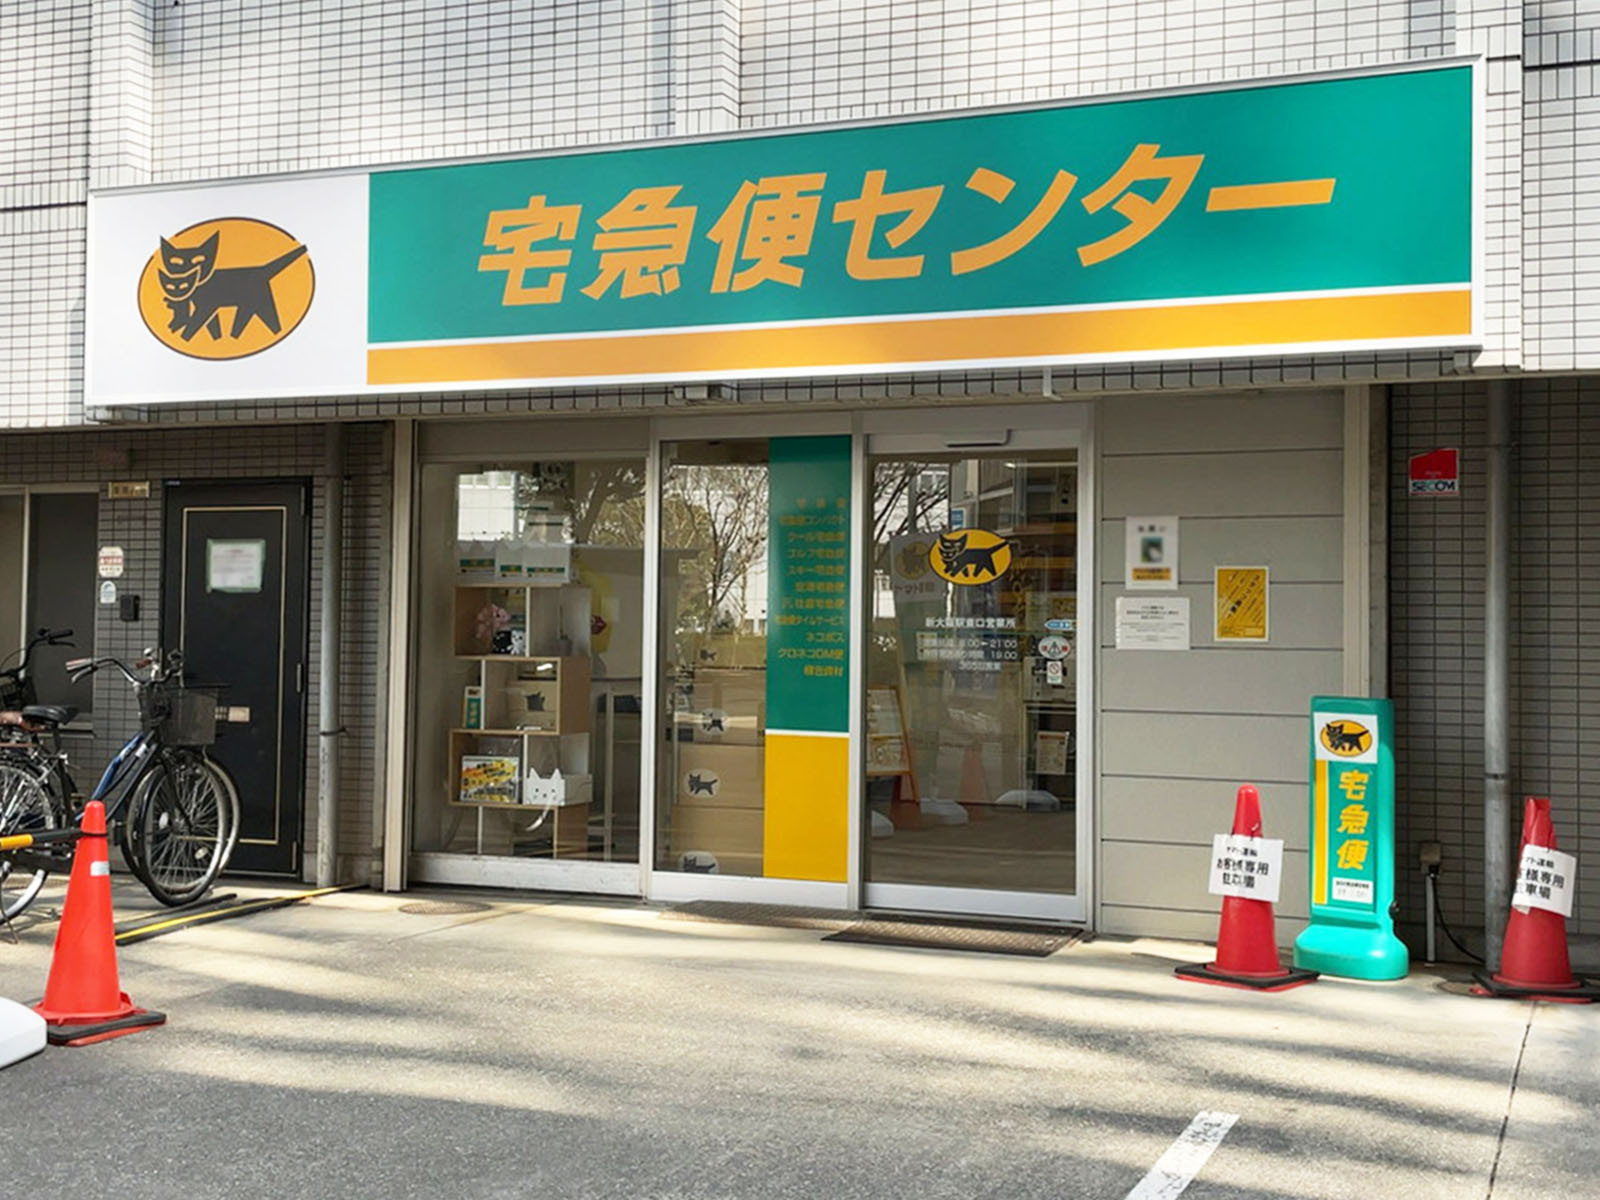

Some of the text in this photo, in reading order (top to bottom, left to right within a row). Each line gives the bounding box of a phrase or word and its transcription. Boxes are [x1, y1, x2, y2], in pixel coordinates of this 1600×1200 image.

[477, 143, 1337, 307] 宅急便センター
[1411, 480, 1456, 491] SECOM
[1336, 769, 1370, 871] 宅急便
